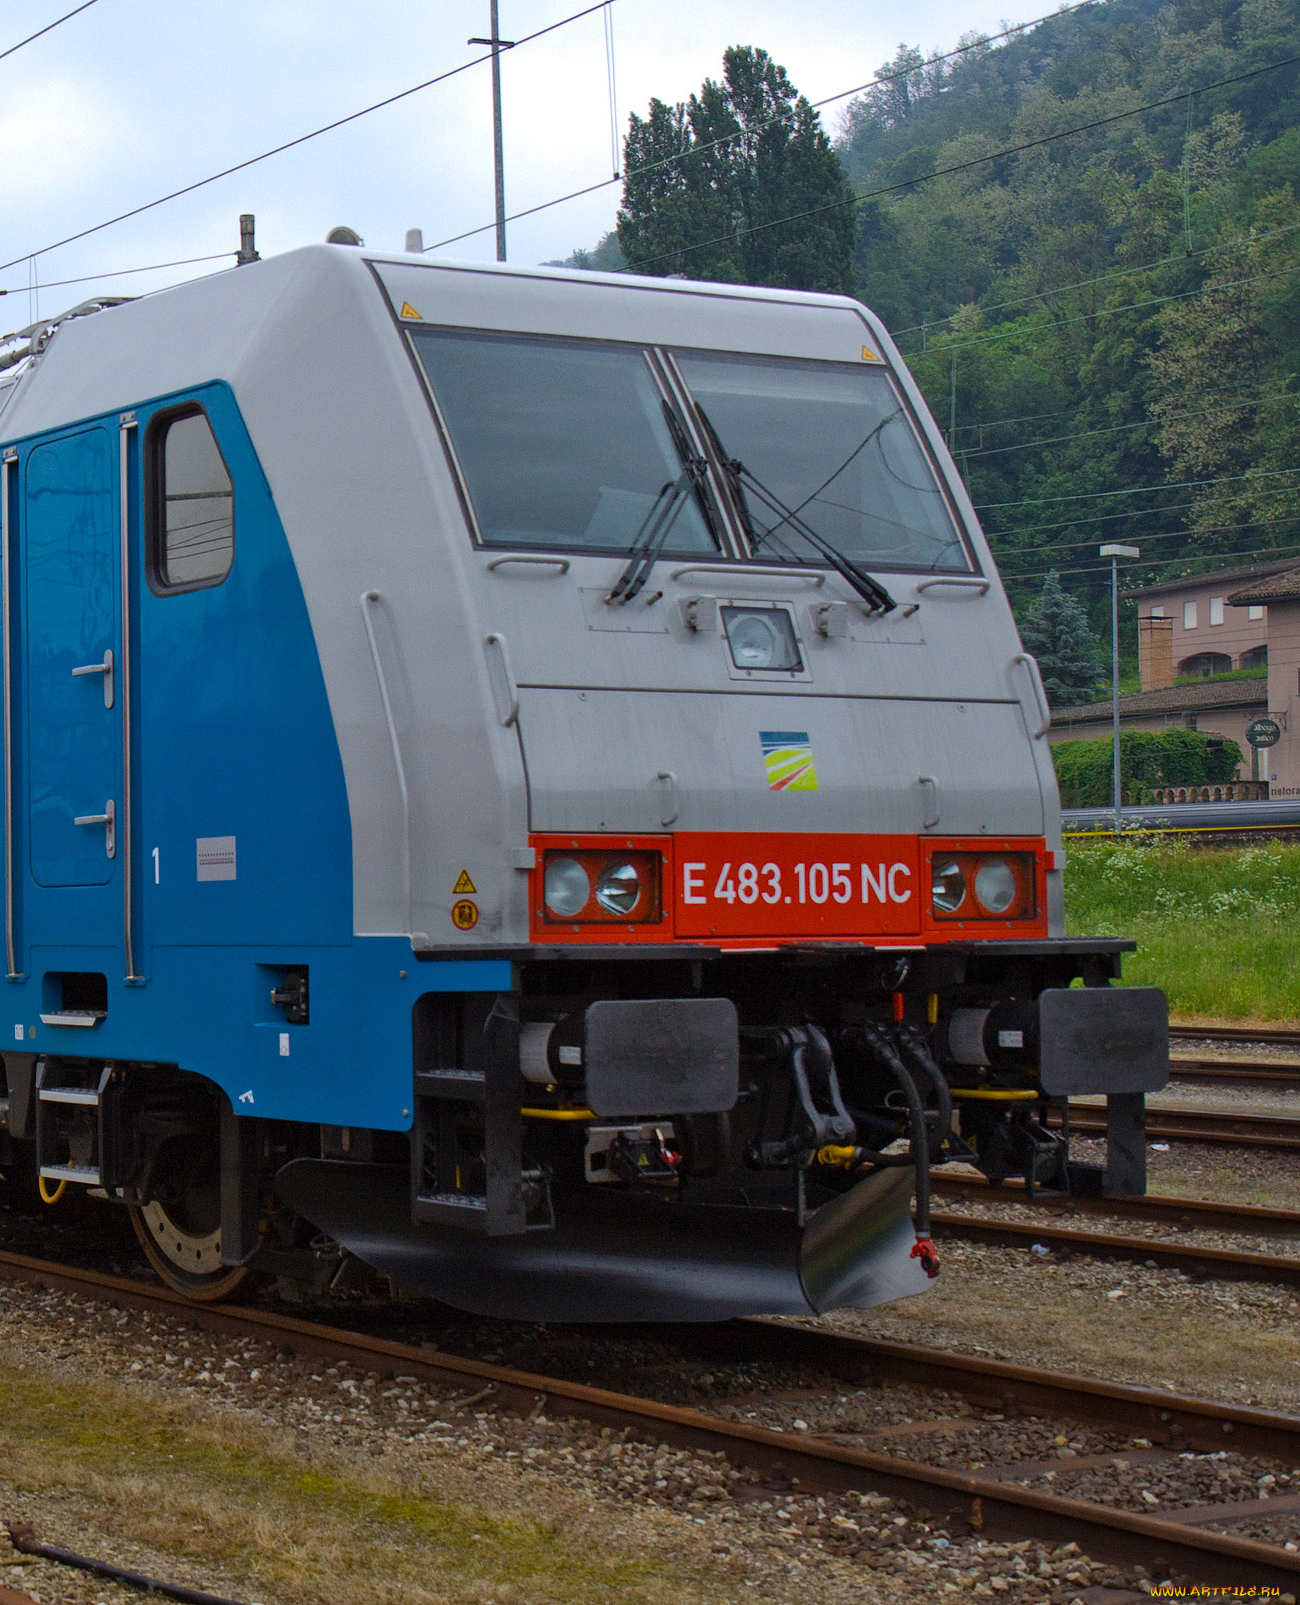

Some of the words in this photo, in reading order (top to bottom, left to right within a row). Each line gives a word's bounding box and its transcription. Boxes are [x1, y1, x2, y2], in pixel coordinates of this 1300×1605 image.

[152, 847, 160, 884] 1
[683, 862, 707, 904] E
[714, 862, 851, 904] 483.105
[861, 862, 911, 904] NC
